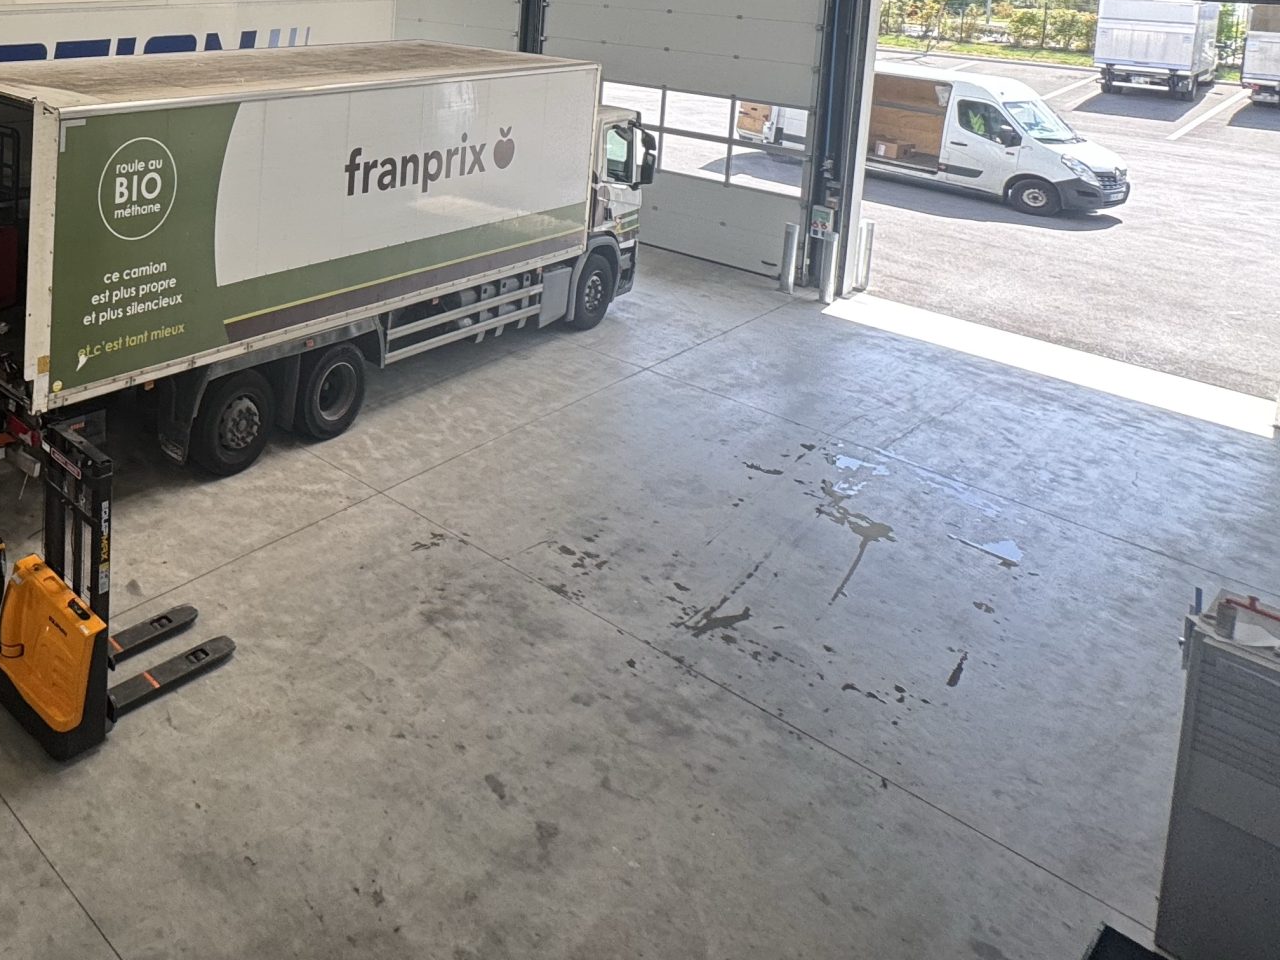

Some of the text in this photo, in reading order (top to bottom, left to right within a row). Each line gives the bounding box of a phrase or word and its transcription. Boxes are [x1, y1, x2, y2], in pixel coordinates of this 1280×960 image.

[115, 159, 163, 174] roule au
[344, 132, 487, 197] franprix
[114, 172, 162, 205] BIO
[114, 203, 161, 219] méthane
[103, 262, 167, 284] ce camion
[91, 277, 177, 305] est plus propre
[83, 293, 183, 325] et plus silencieux
[93, 338, 122, 356] c'est
[125, 331, 149, 347] tant
[150, 323, 185, 341] mieux
